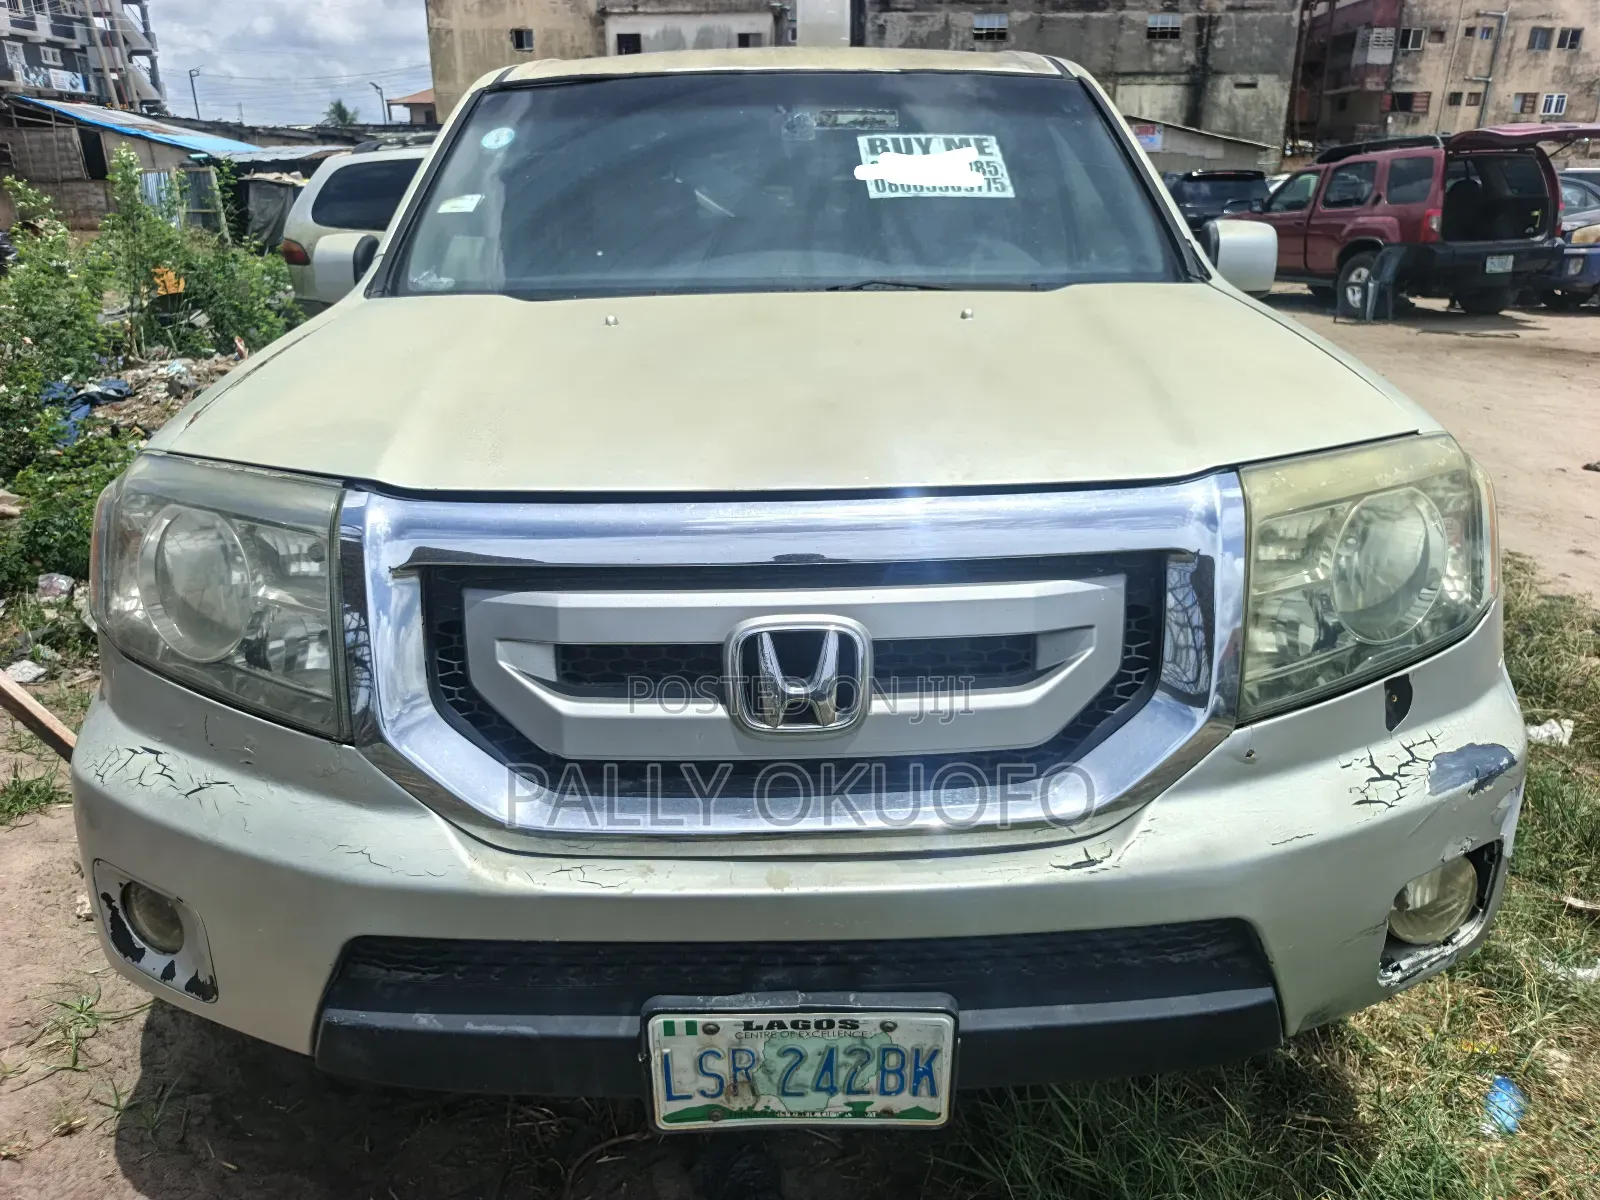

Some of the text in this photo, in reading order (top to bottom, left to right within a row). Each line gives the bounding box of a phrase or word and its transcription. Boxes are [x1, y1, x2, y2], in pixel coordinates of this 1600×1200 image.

[867, 137, 994, 156] BUY ME
[742, 1018, 860, 1032] LAGOS
[735, 1029, 869, 1040] CENTRE OF EXCELLENCE
[661, 1045, 943, 1101] LSR 242BK
